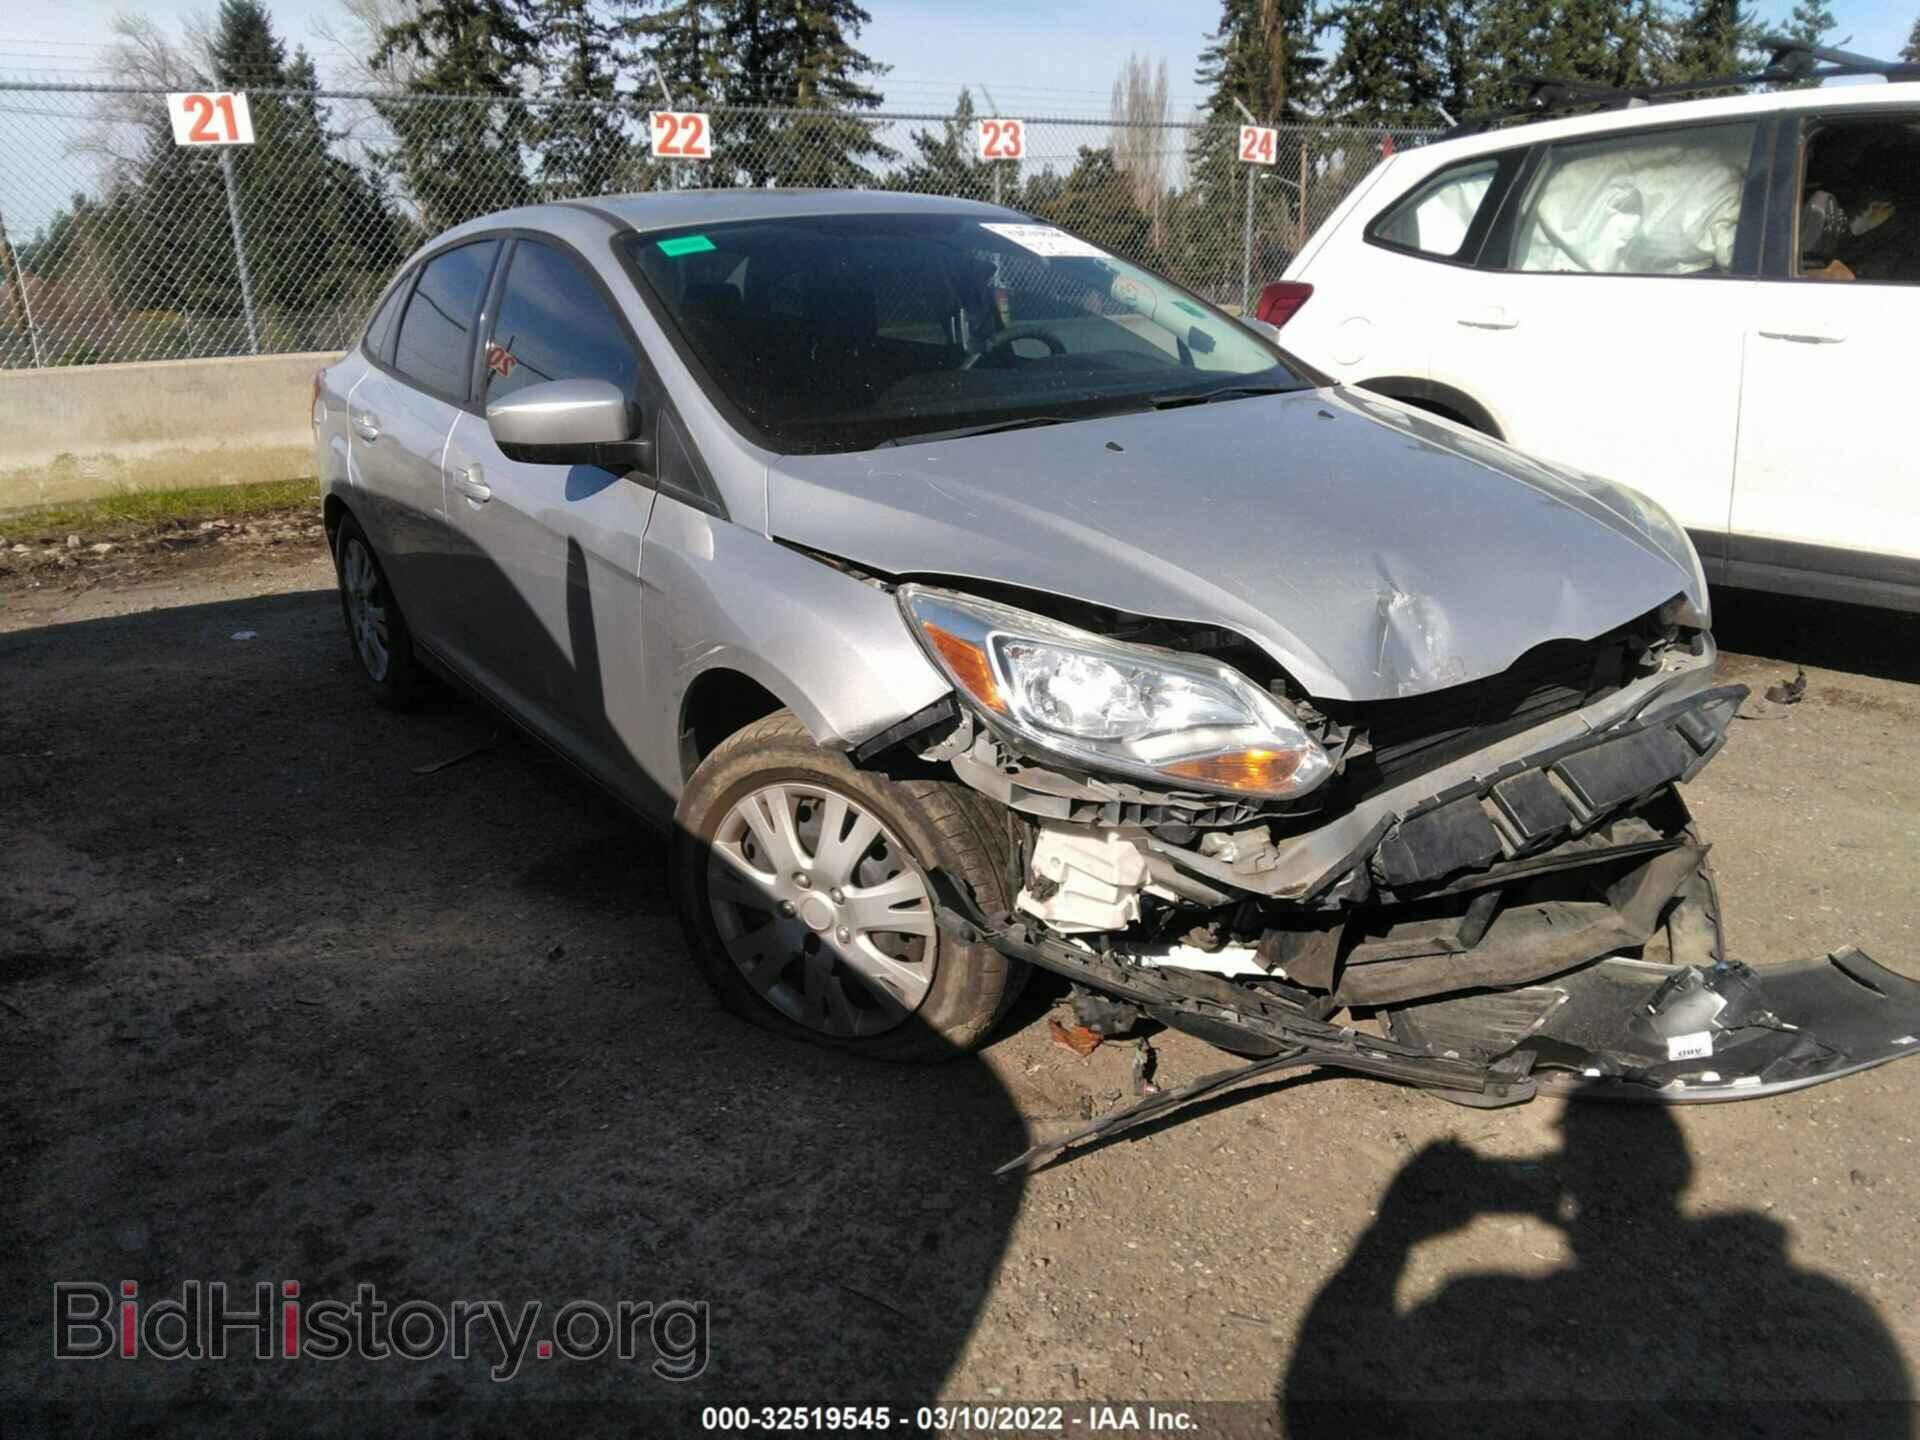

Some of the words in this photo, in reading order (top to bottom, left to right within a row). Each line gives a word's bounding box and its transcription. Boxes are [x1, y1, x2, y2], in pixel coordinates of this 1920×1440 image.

[183, 94, 239, 141] 21
[655, 113, 705, 154] 22
[983, 121, 1021, 156] 23
[1242, 127, 1273, 161] 24
